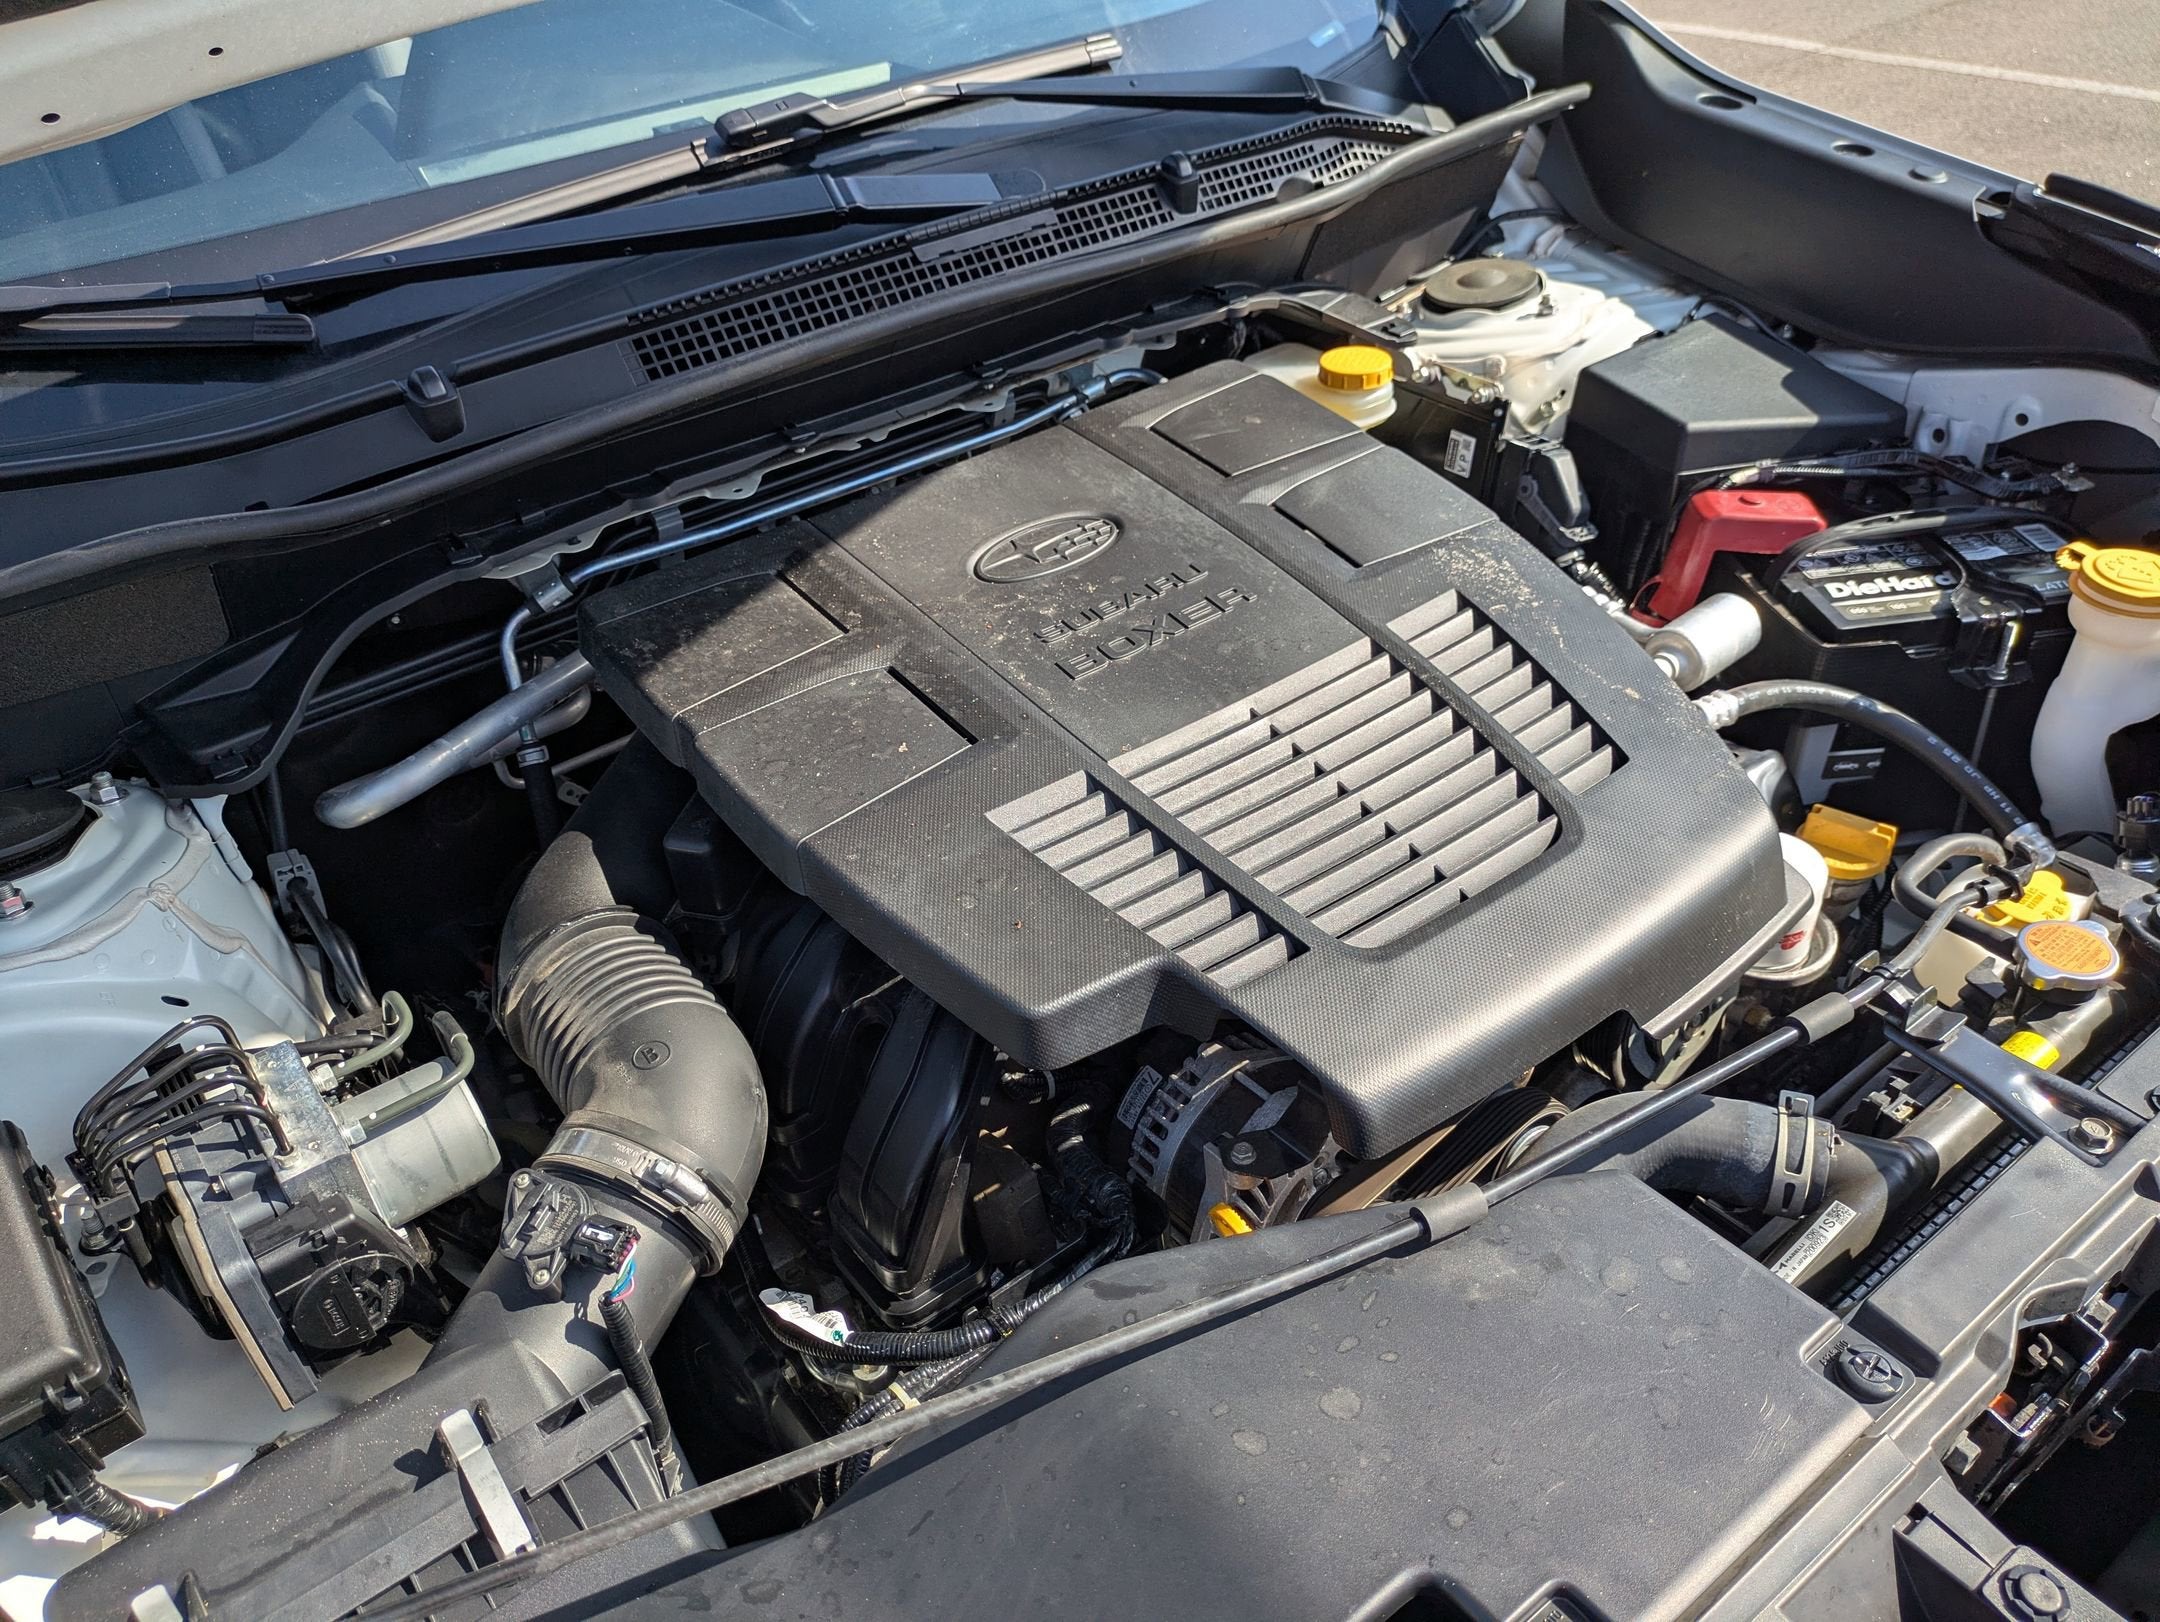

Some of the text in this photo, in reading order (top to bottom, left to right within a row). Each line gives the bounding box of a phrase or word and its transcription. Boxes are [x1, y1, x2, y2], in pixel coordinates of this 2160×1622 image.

[1033, 563, 1208, 643] SUBARU
[1824, 571, 1958, 599] DieHard
[1054, 587, 1257, 681] BOXER
[1785, 1242, 1806, 1264] MARELLI
